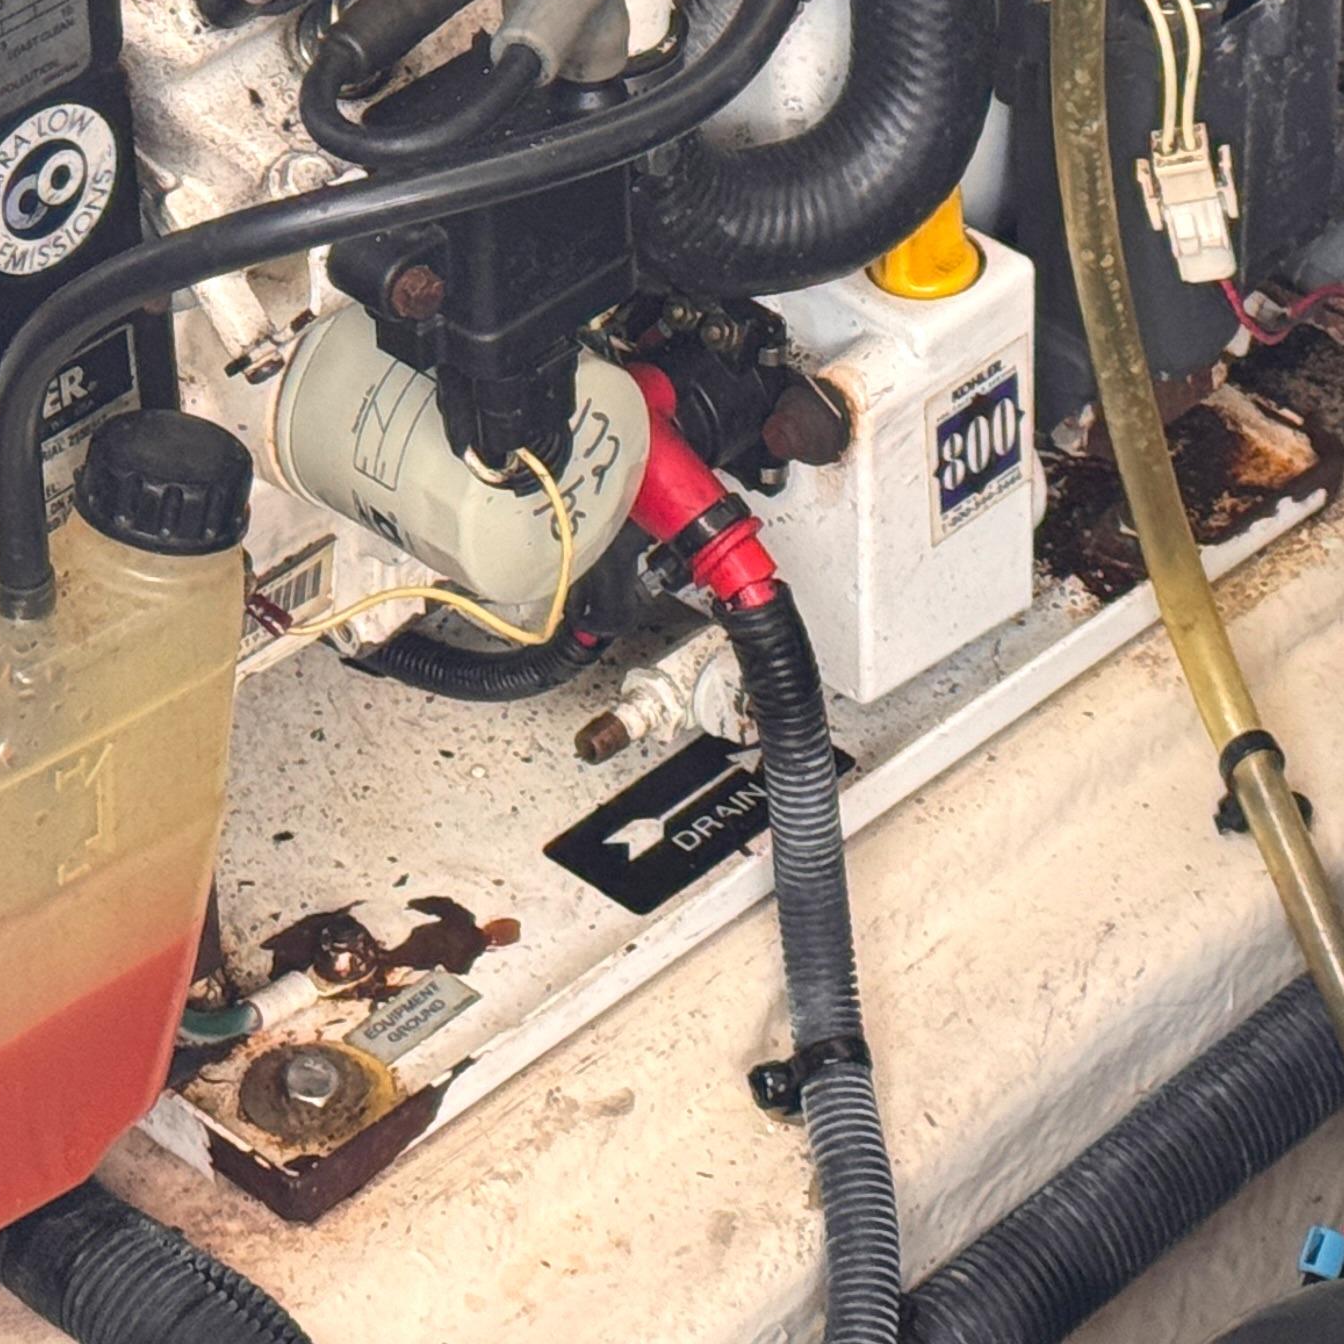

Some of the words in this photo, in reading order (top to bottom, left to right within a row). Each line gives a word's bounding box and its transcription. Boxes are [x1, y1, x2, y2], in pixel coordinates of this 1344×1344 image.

[33, 108, 95, 137] LOW
[941, 396, 1018, 492] 800
[671, 780, 768, 853] DRAIN
[362, 979, 442, 1041] EQUIPMENT
[386, 998, 447, 1044] GROUND
